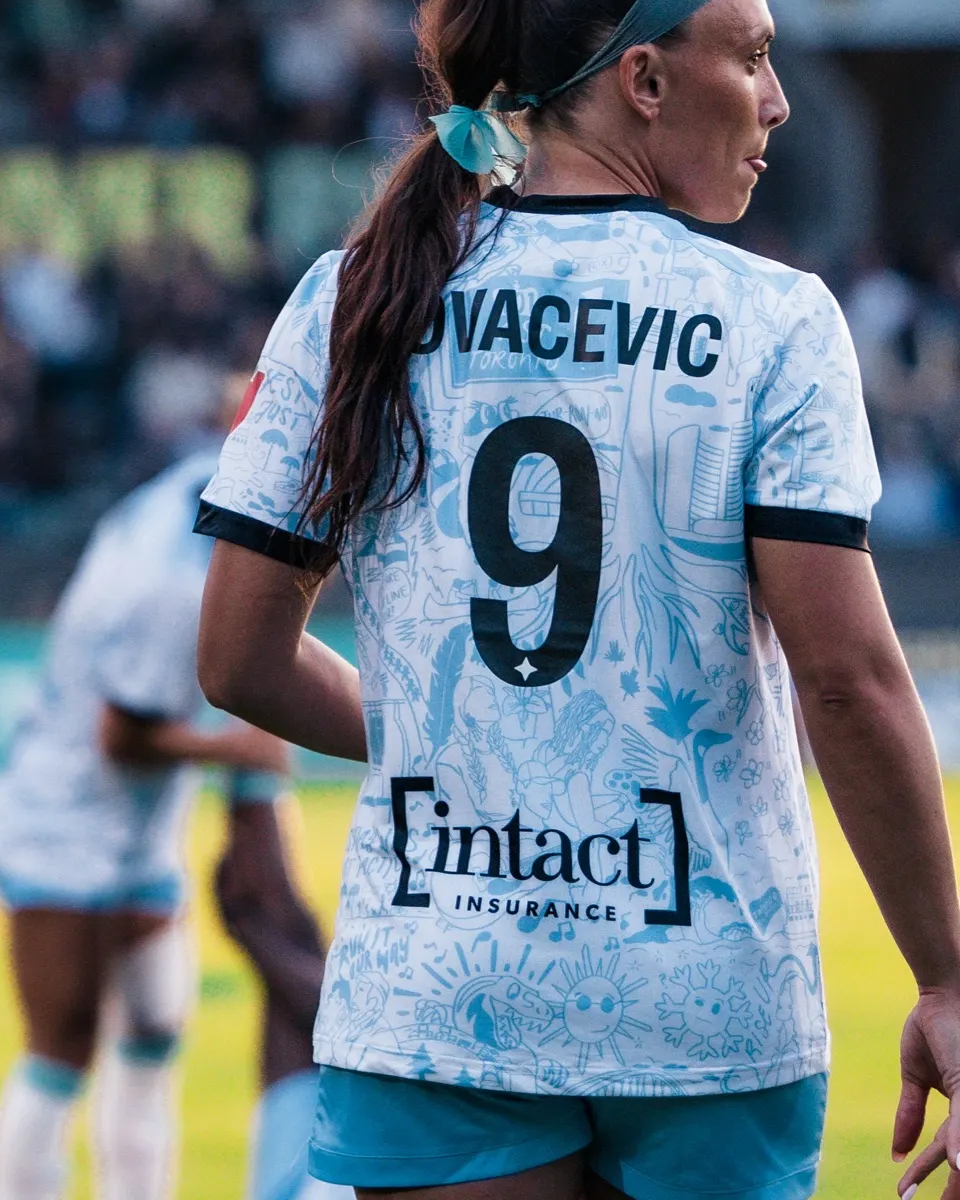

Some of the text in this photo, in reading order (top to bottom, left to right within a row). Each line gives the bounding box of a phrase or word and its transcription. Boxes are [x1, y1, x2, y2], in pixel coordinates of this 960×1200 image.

[411, 288, 723, 378] OVACEVIC
[466, 415, 604, 687] 9
[425, 800, 656, 889] intact
[455, 895, 617, 922] INSURANCE
